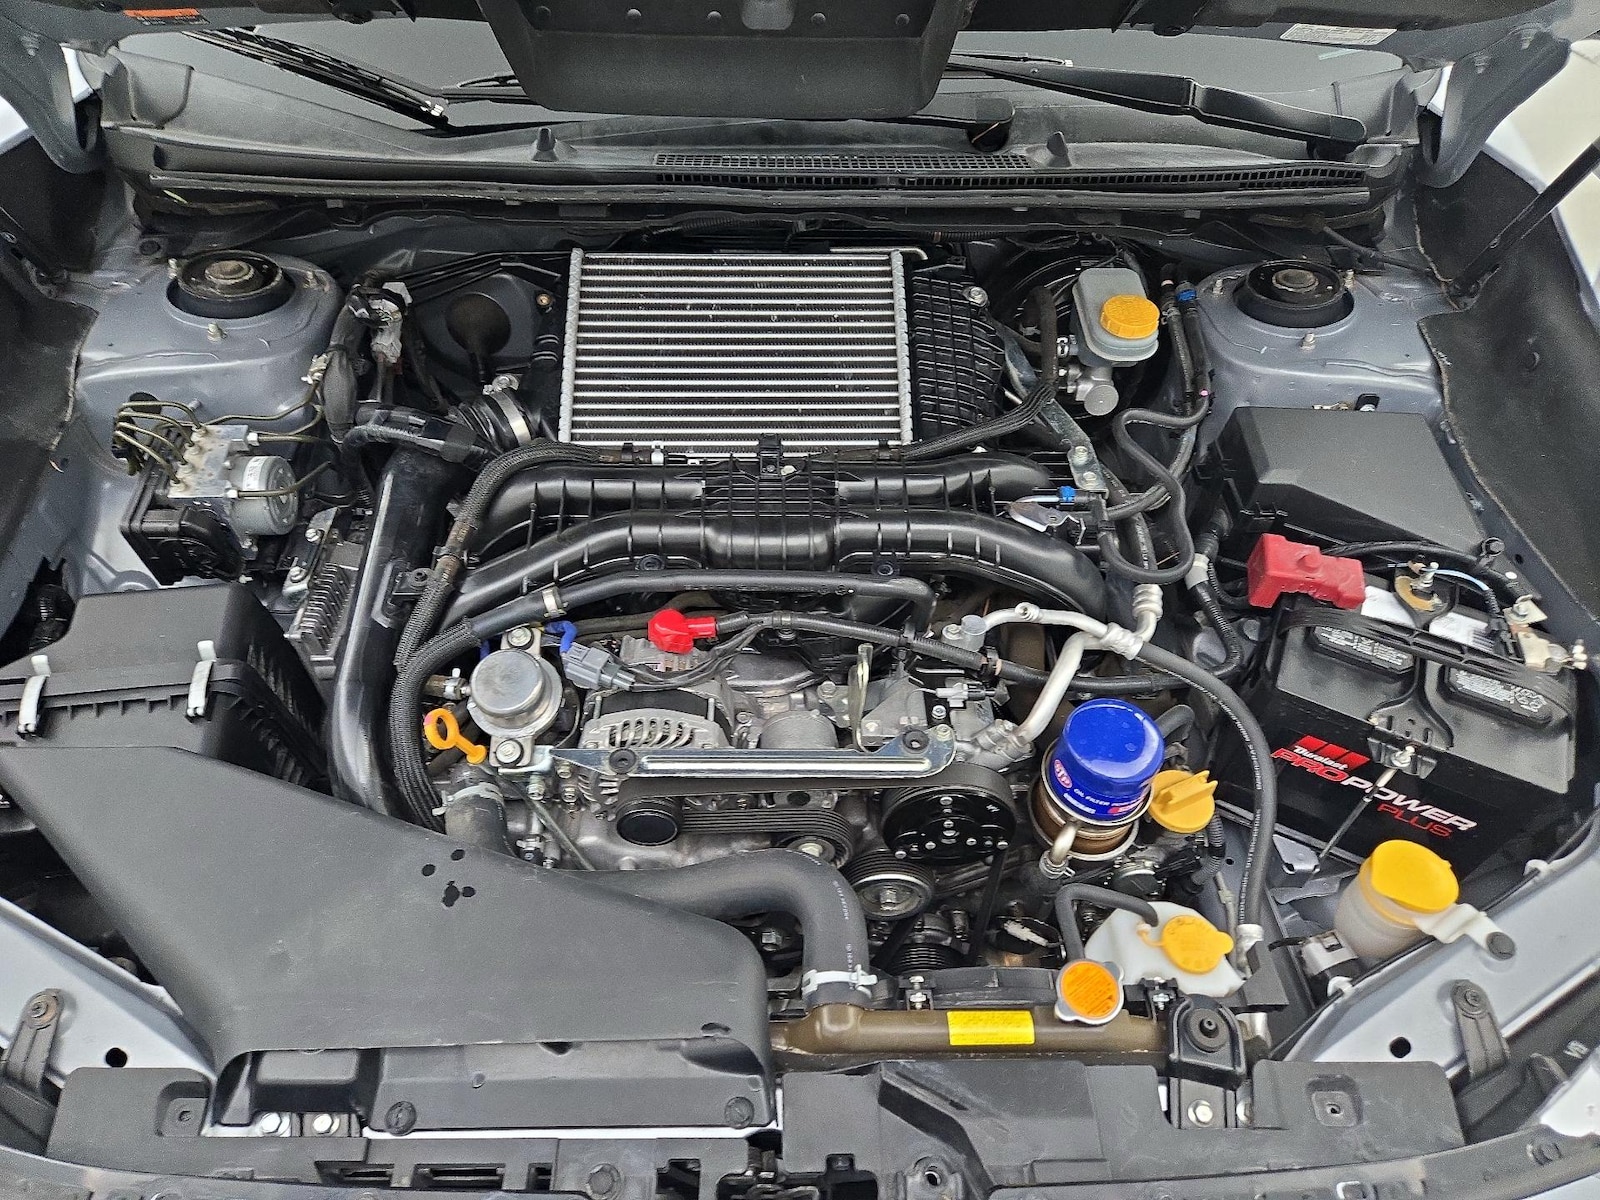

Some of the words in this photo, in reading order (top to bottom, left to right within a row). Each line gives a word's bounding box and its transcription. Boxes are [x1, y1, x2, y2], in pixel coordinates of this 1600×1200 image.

[1294, 745, 1348, 770] Duralast
[1074, 788, 1085, 798] OIL
[1377, 803, 1453, 838] PLUS
